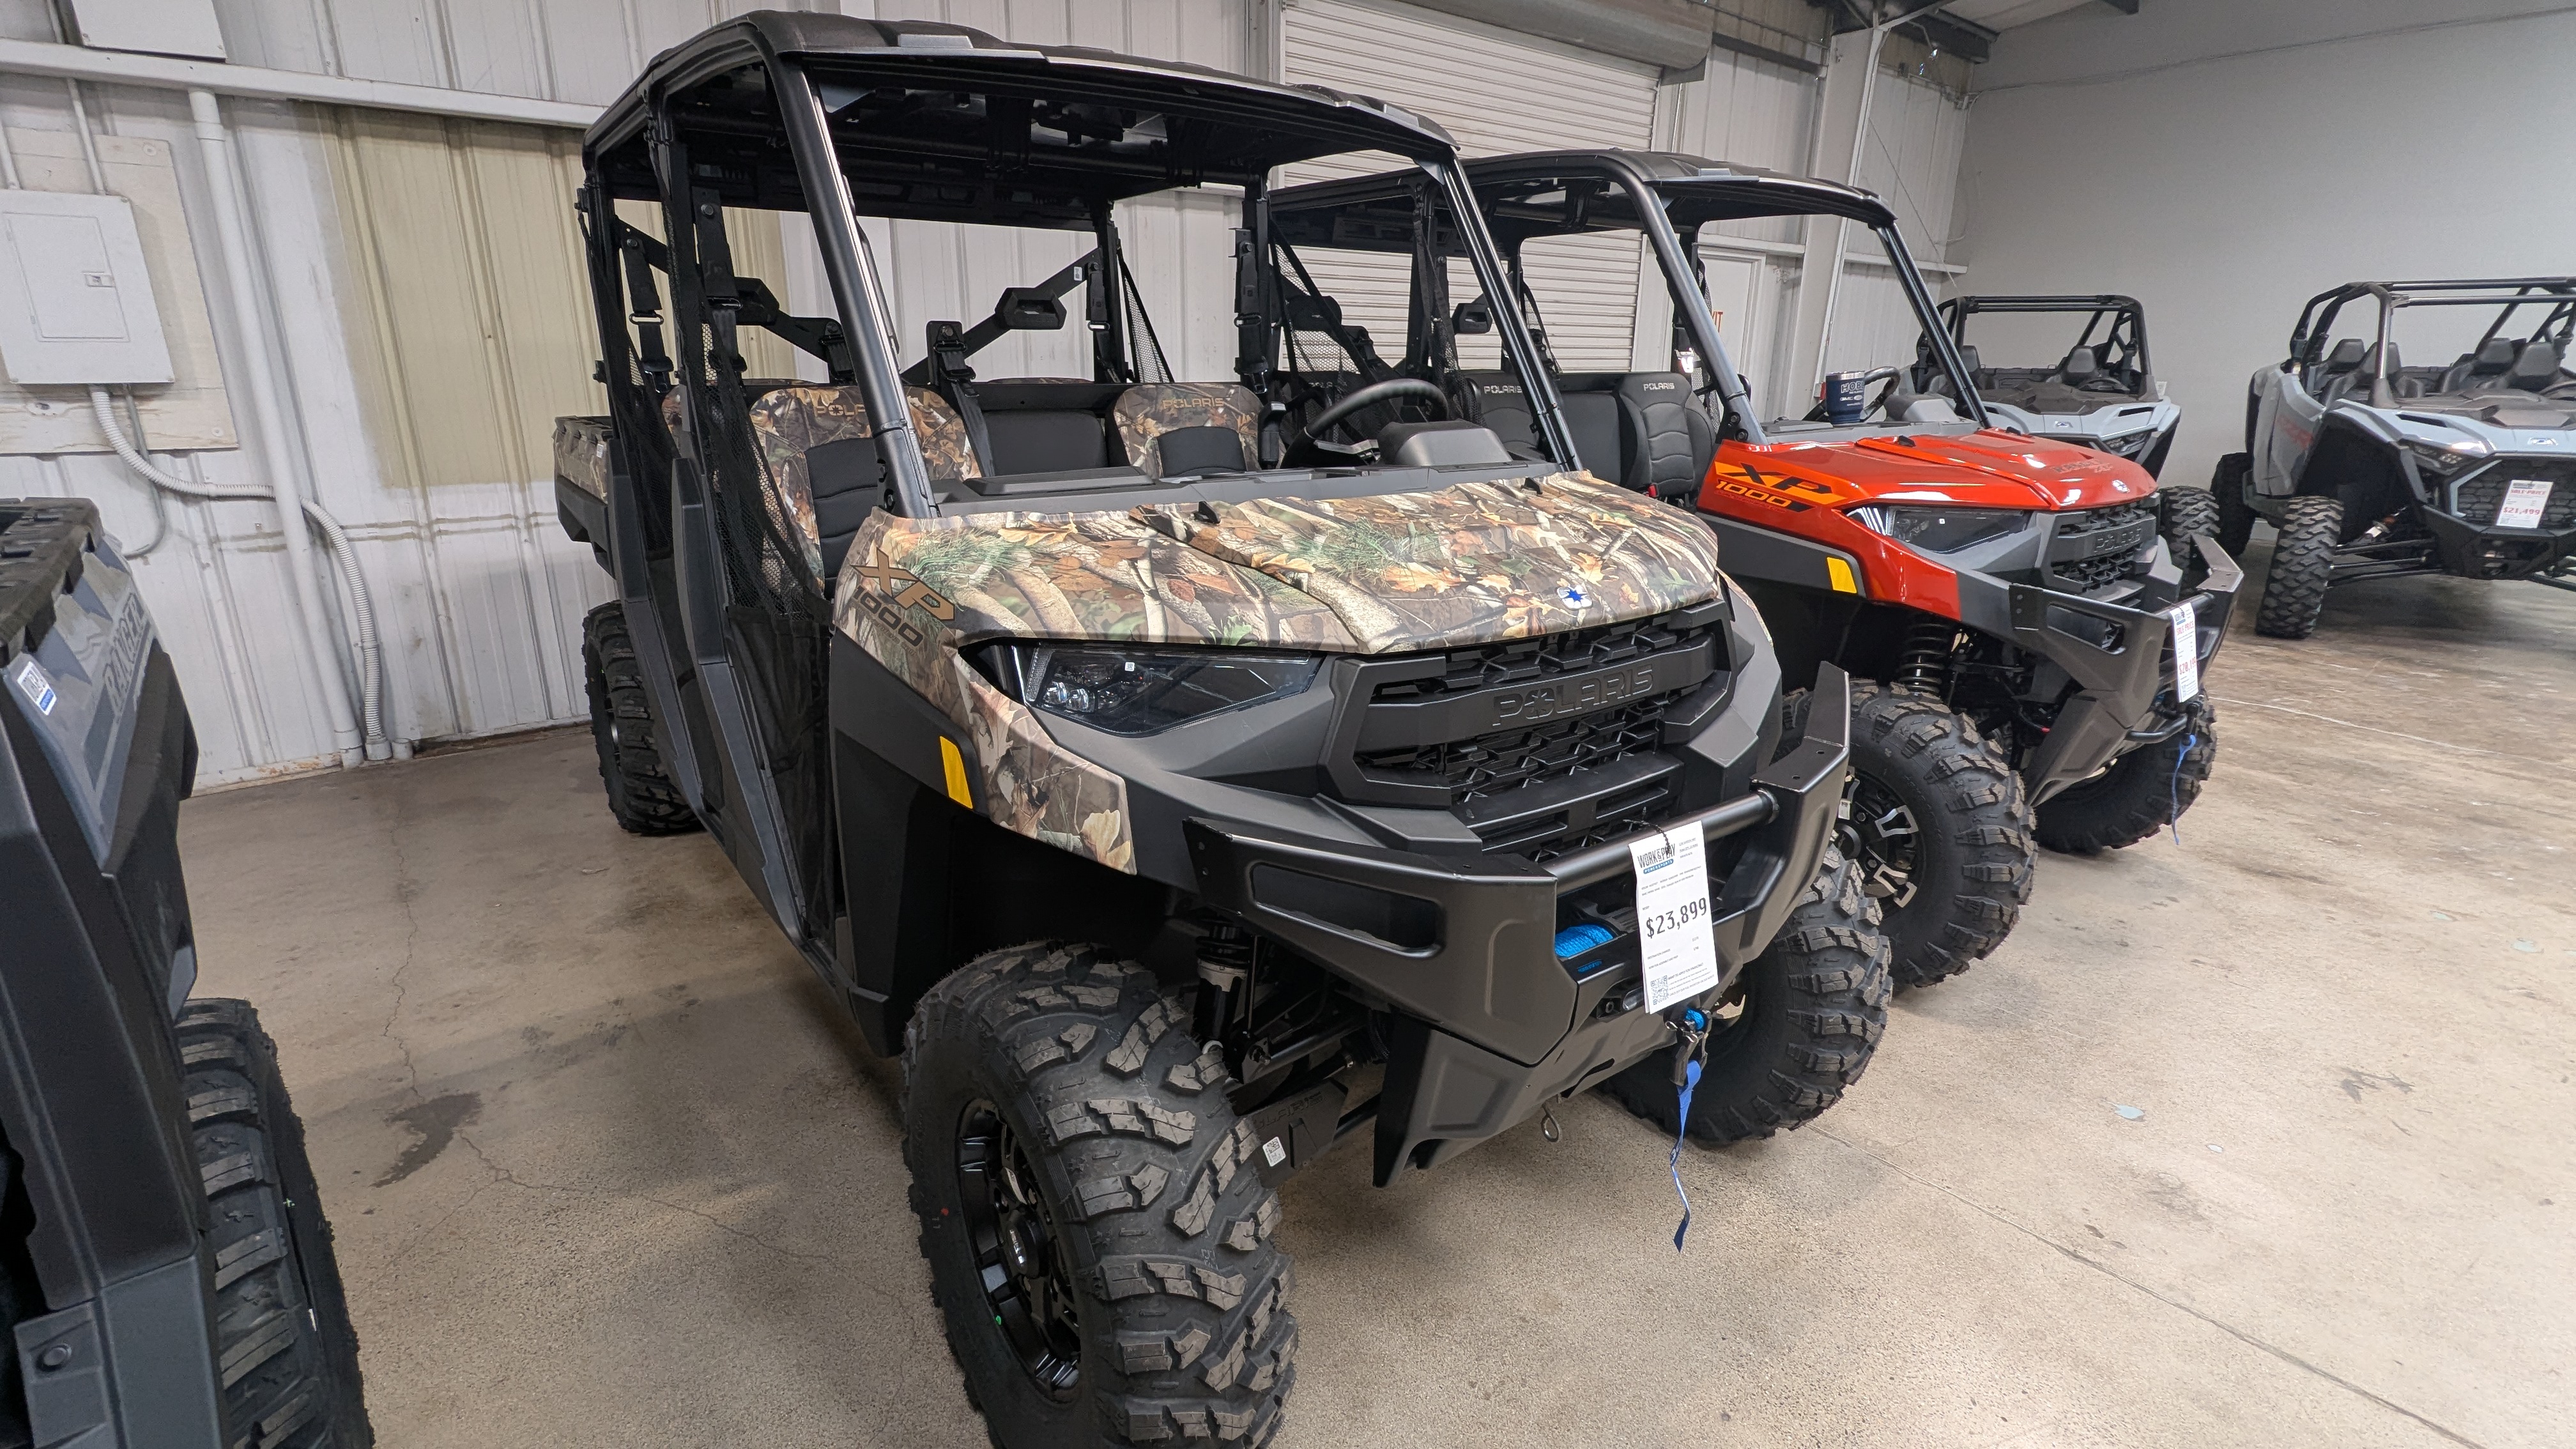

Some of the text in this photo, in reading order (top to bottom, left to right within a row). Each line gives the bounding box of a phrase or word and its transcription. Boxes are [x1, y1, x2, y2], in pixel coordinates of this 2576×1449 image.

[1483, 385, 1522, 394] POLARIS
[1643, 382, 1675, 391] POLARIS
[813, 404, 866, 418] POLA
[1163, 397, 1224, 410] POLARIS
[1717, 462, 1834, 494] XP
[1715, 480, 1792, 508] 1000
[2503, 507, 2541, 515] $21,499
[850, 546, 955, 622] XP
[852, 585, 924, 647] 1000
[1492, 664, 1654, 726] POLARIS
[1646, 897, 1707, 939] $23,899
